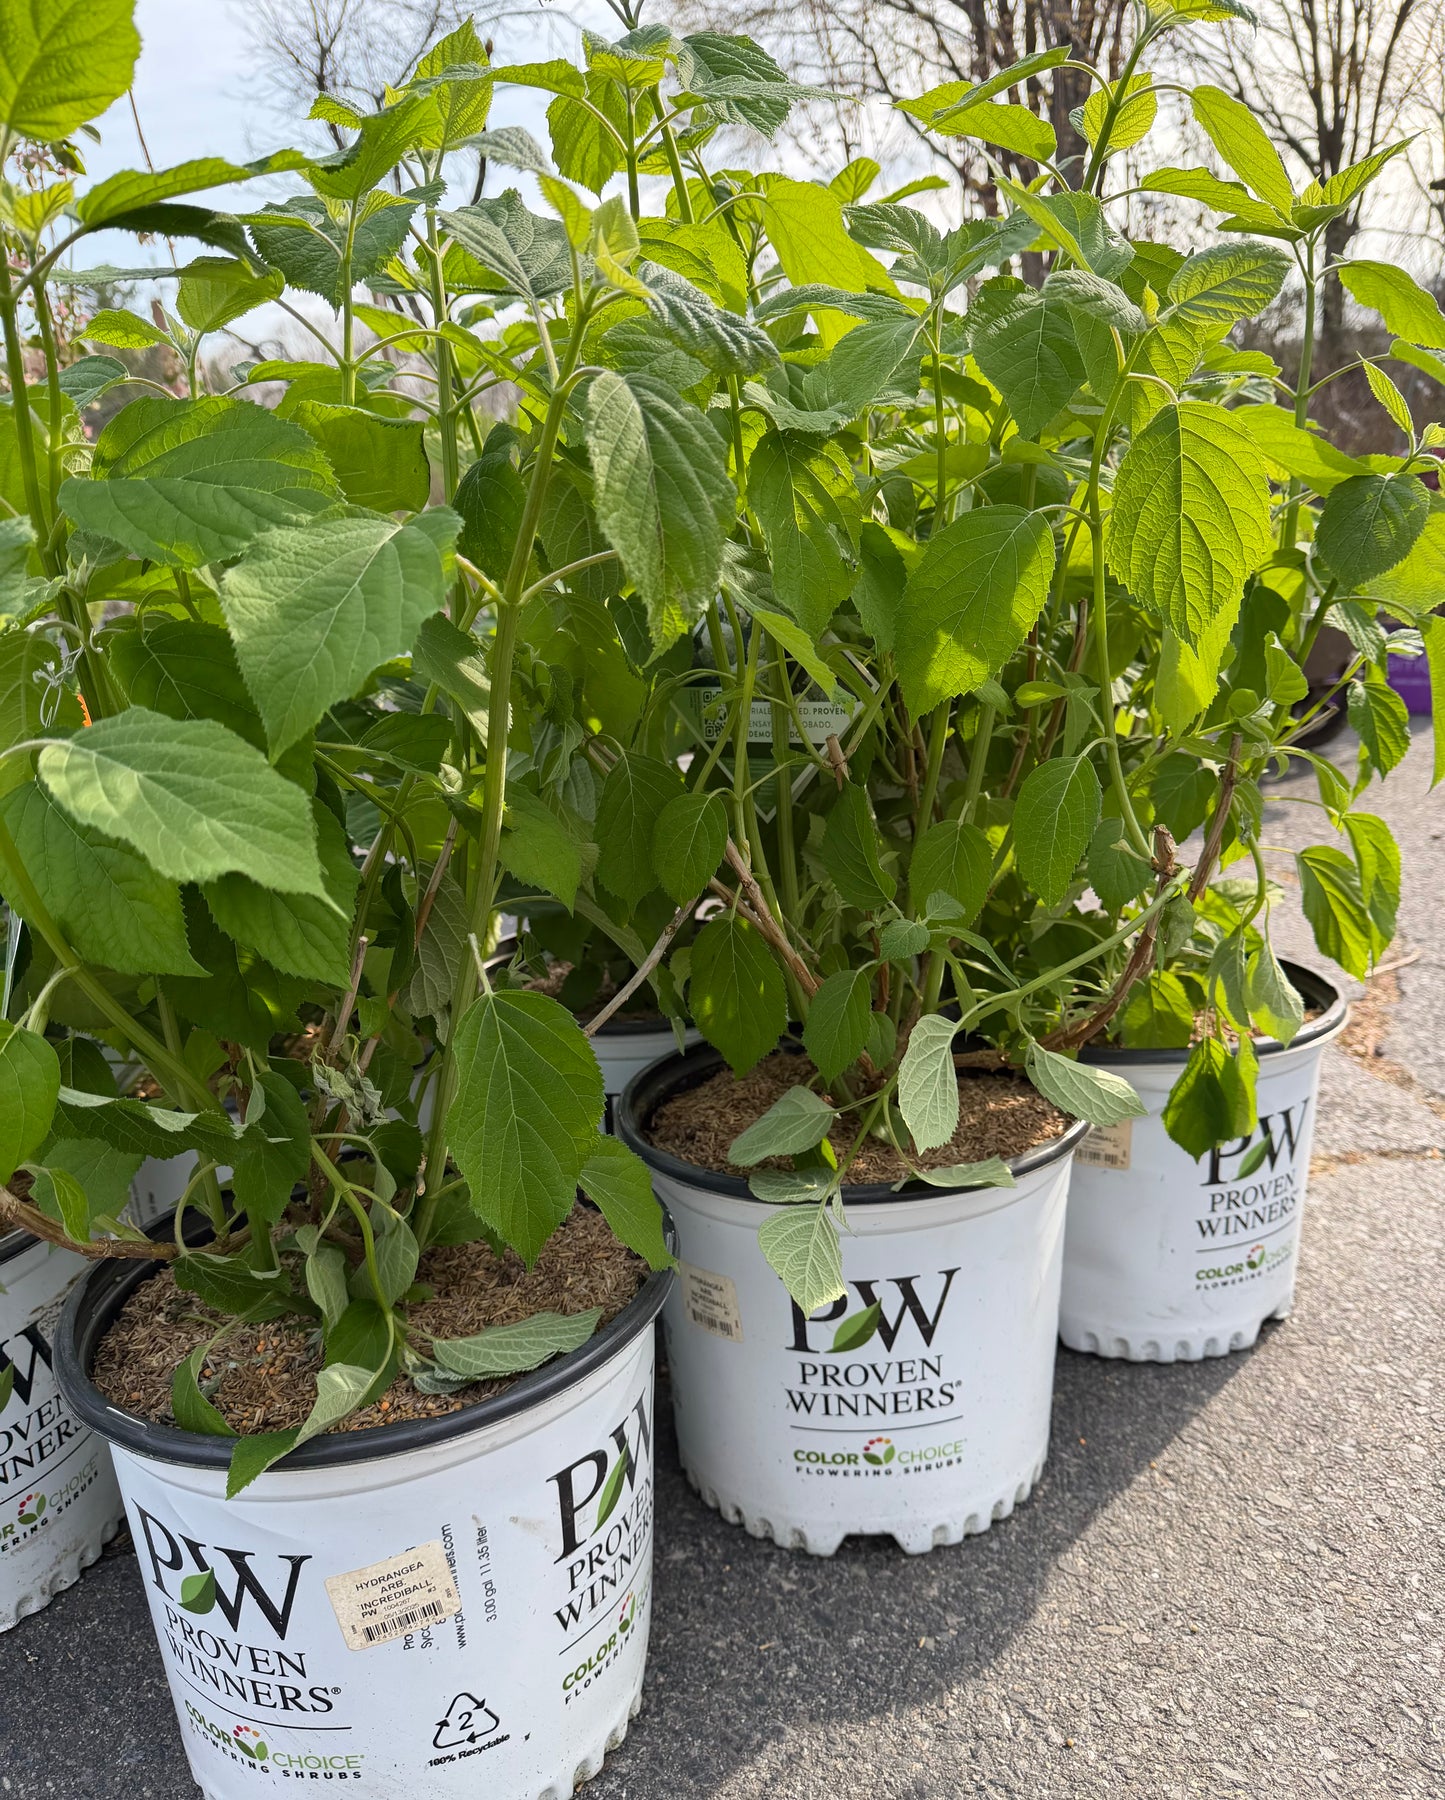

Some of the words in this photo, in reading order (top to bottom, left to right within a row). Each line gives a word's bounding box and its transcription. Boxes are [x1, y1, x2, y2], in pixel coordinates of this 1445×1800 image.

[792, 721, 833, 729] POBADO.
[1209, 1168, 1297, 1214] PROVEN
[1195, 1262, 1245, 1281] COLOR
[797, 1354, 943, 1388] PROVEN
[793, 1449, 859, 1465] COLOR
[795, 1466, 893, 1478] FLOWERING
[903, 1455, 963, 1474] SHRUBS
[475, 1526, 488, 1546] liter
[130, 1497, 313, 1641] PW
[355, 1561, 424, 1592] HYDRANGEA
[380, 1580, 407, 1594] ARB.
[482, 1579, 496, 1598] gal
[361, 1608, 378, 1618] PW
[484, 1598, 497, 1623] 3.00
[163, 1601, 306, 1680] PROVEN
[562, 1632, 617, 1691] COLOR
[184, 1699, 234, 1748] COLOR
[457, 1711, 474, 1731] 2
[189, 1717, 270, 1774] FLOWERING
[282, 1769, 362, 1780] SHRUBS
[427, 1754, 457, 1767] 100%
[458, 1734, 511, 1760] Recyclable
